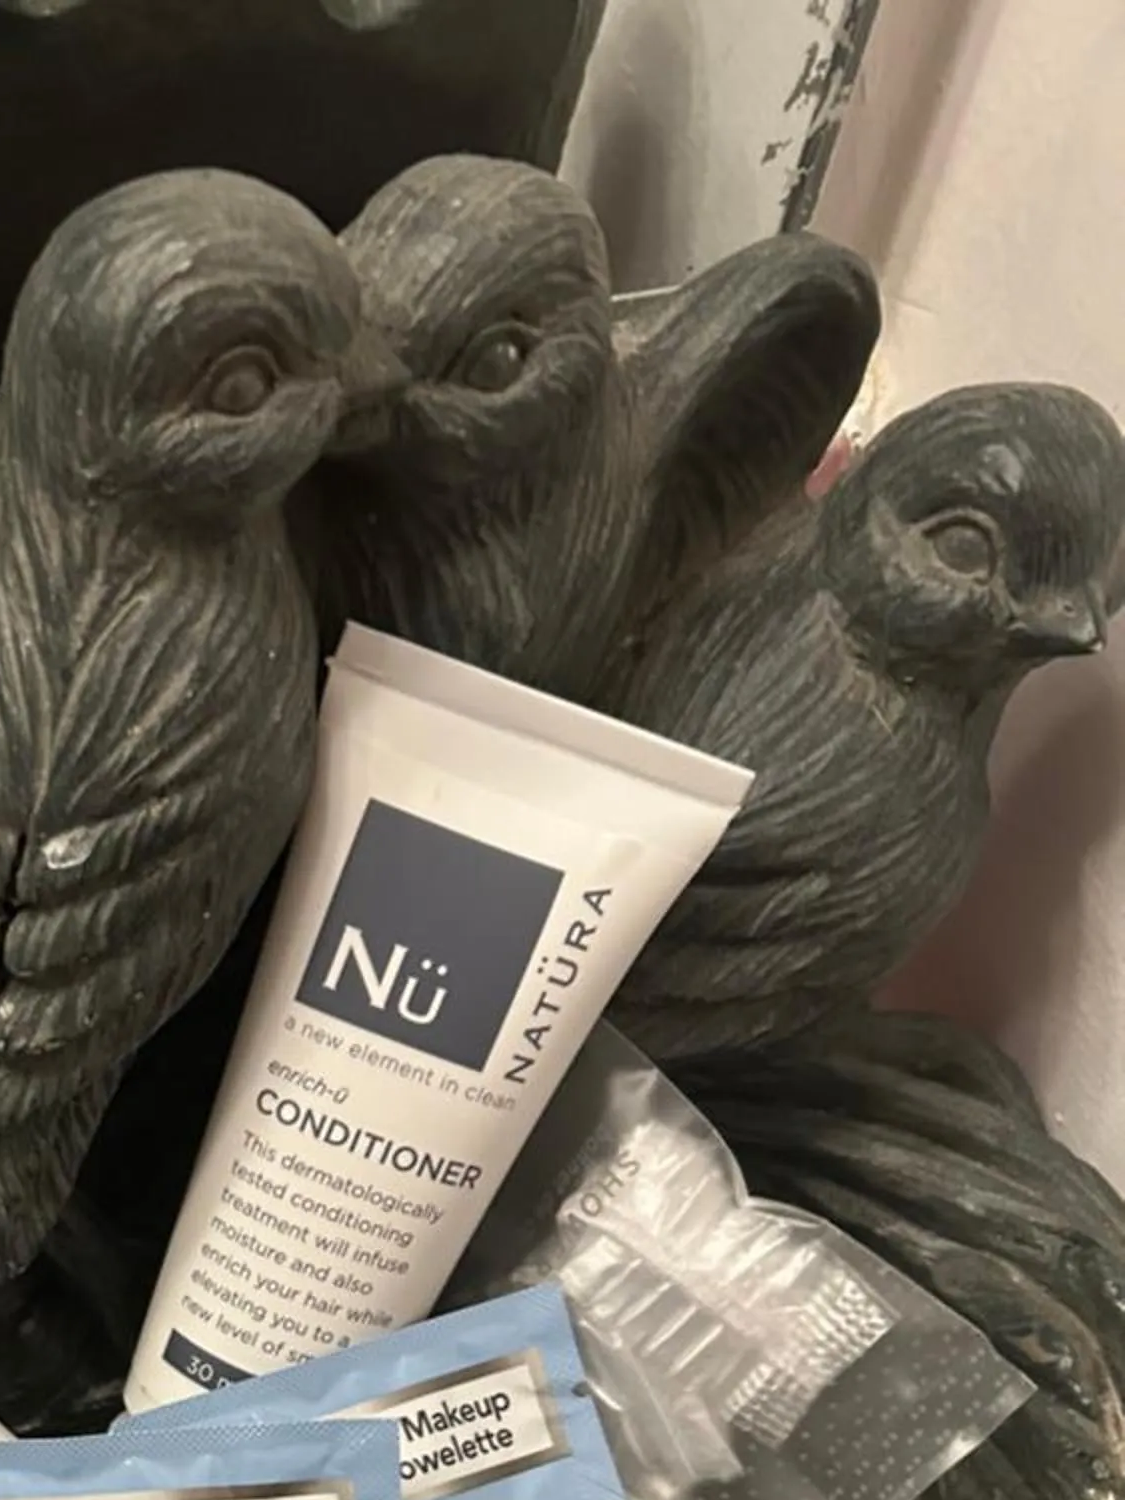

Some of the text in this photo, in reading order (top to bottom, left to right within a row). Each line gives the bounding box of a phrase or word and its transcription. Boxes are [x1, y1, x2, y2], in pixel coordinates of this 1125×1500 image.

[322, 925, 448, 1025] Nü
[503, 887, 612, 1084] NATÜRA
[284, 1018, 516, 1113] a new element in clean
[242, 1130, 444, 1225] This dermatologically
[255, 1087, 483, 1190] CONDITIONER
[221, 1187, 410, 1276] treatment will infuse
[230, 1159, 414, 1249] tested conditioning
[200, 1241, 396, 1328] enrich your hair while
[209, 1214, 374, 1296] moisture and also
[181, 1293, 213, 1323] new
[216, 1313, 258, 1347] level
[262, 1336, 283, 1356] of
[191, 1267, 351, 1348] elevating you to a
[186, 1356, 214, 1382] 30
[400, 1392, 510, 1442] Makeup
[400, 1428, 513, 1480] owelette
